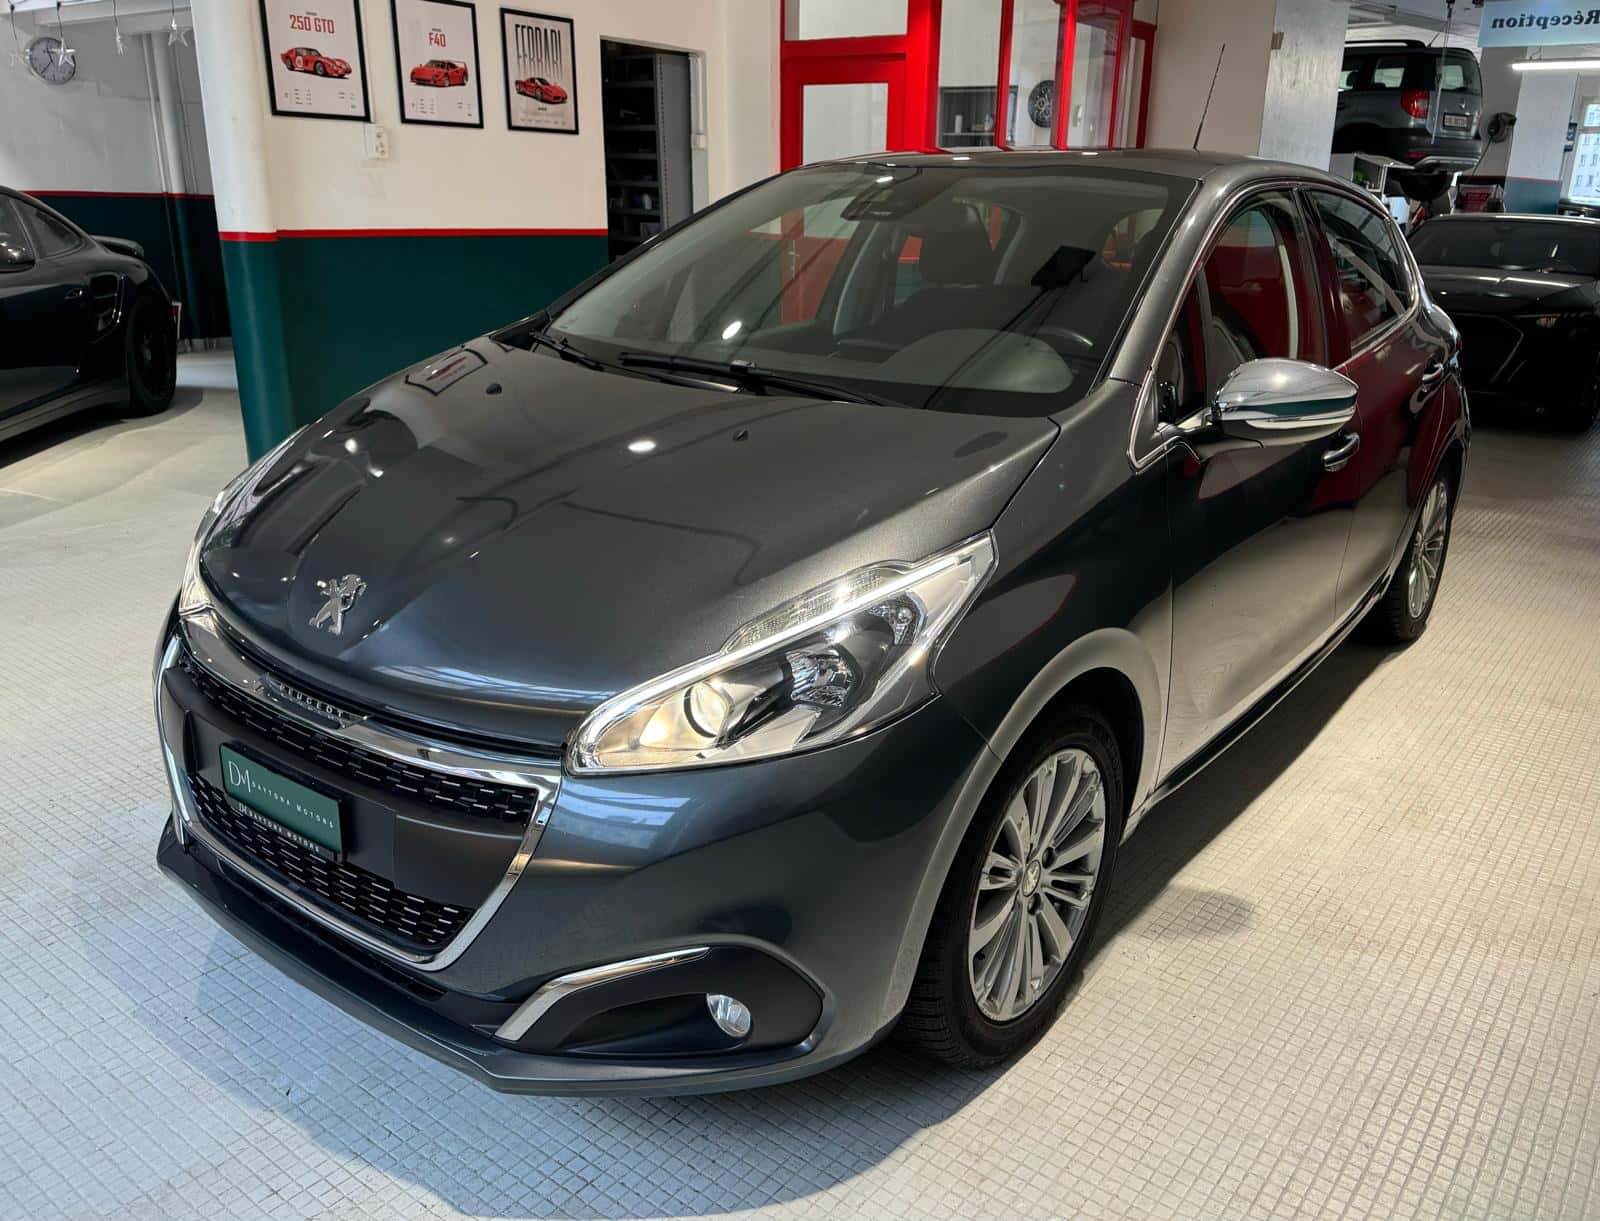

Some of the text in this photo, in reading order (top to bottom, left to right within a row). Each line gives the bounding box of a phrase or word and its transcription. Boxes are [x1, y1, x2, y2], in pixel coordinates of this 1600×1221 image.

[289, 14, 335, 34] 250 GTO
[428, 31, 446, 48] F40
[515, 23, 562, 73] FERRARI
[279, 682, 344, 718] PEUGEOT
[296, 804, 334, 829] MOTORS
